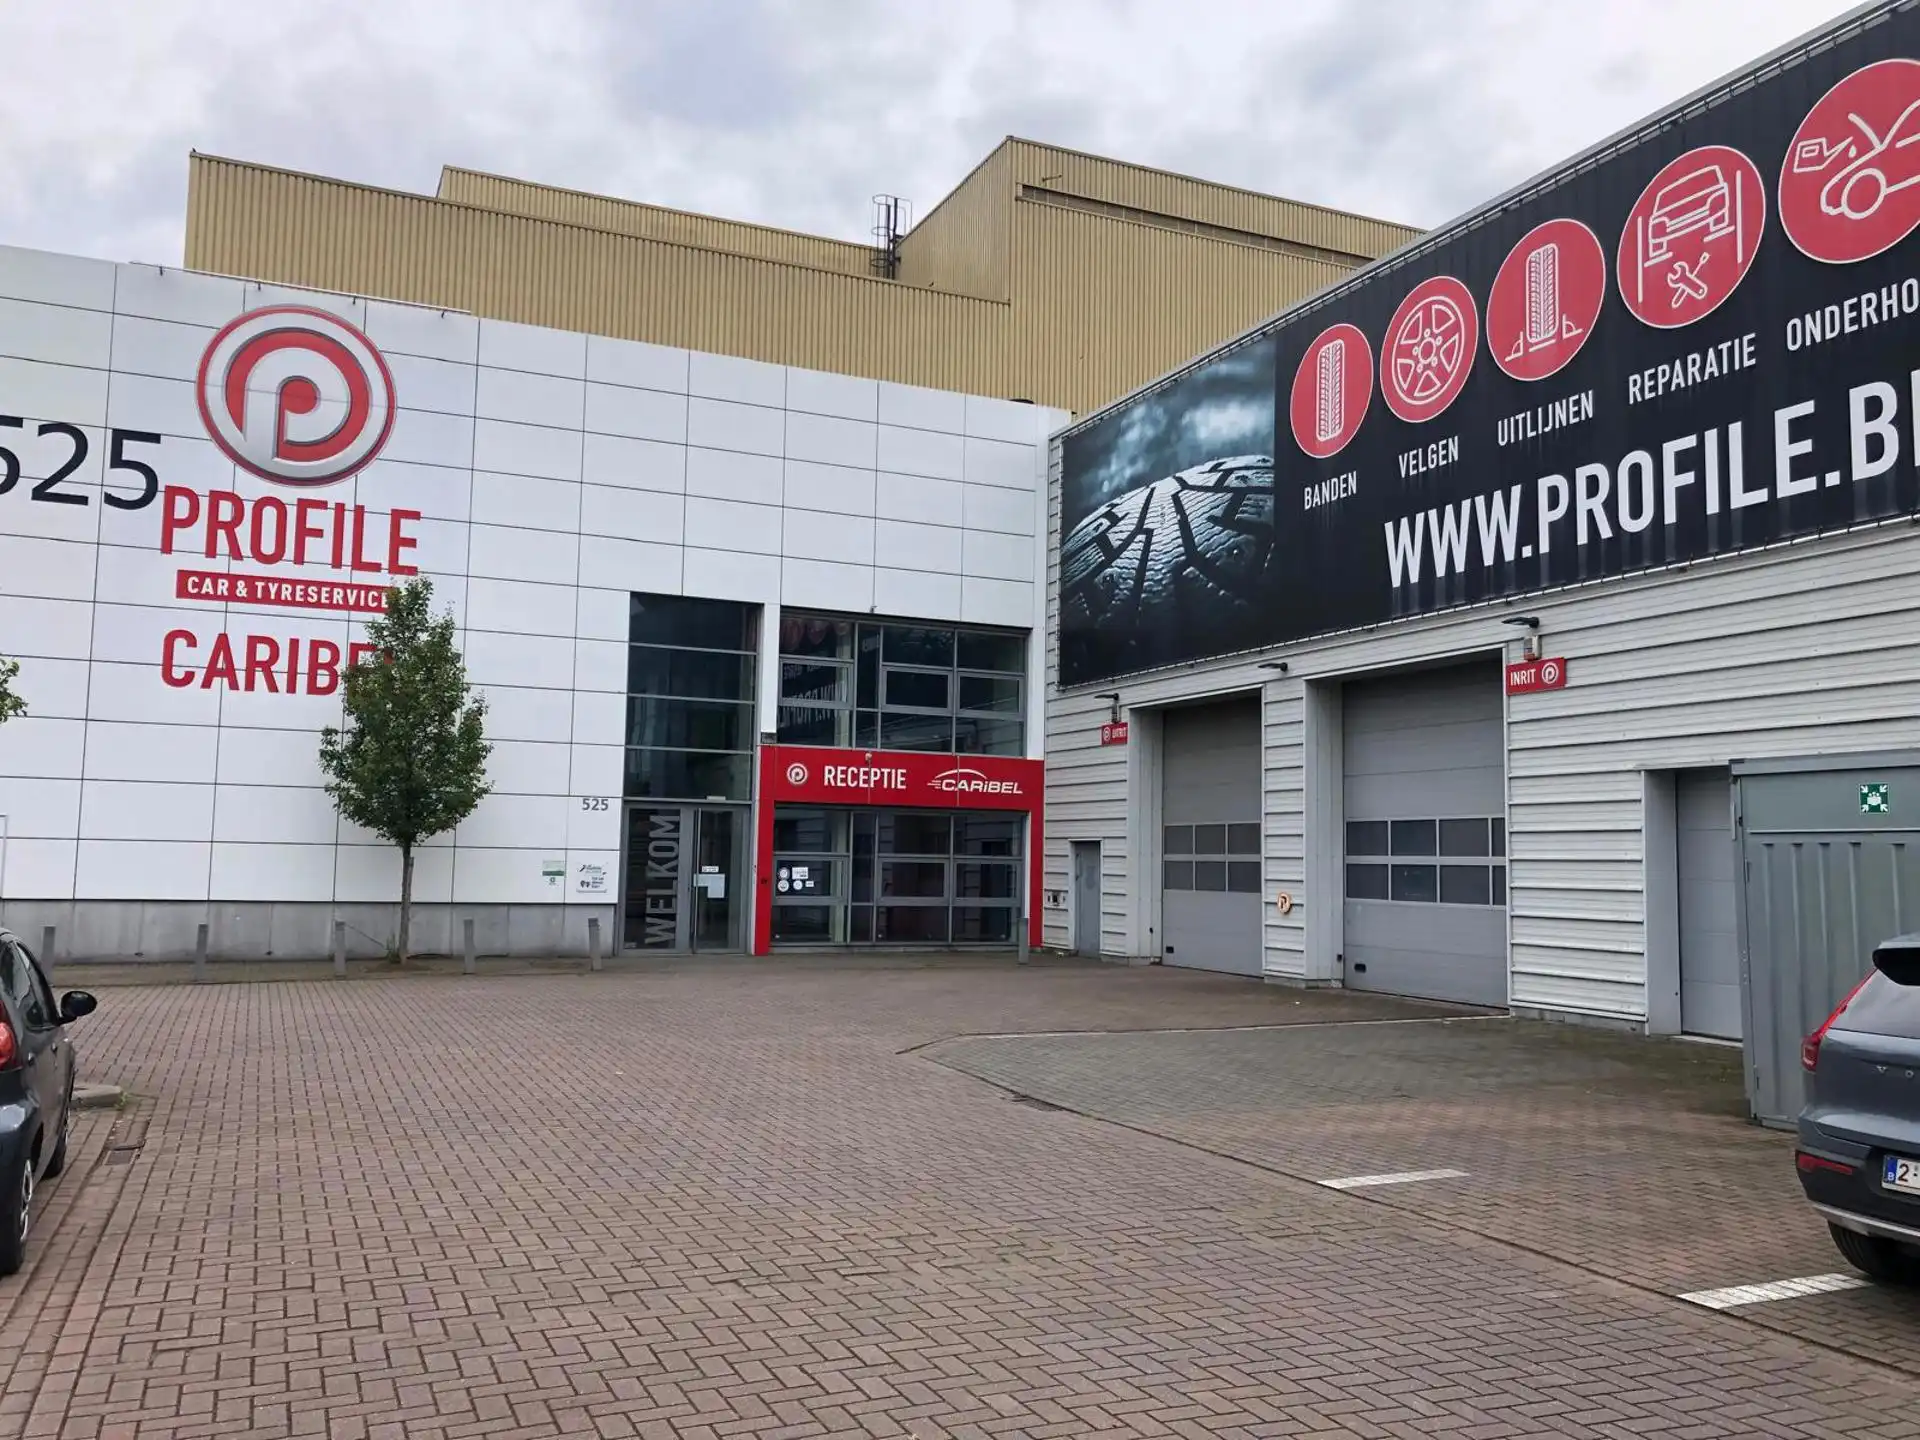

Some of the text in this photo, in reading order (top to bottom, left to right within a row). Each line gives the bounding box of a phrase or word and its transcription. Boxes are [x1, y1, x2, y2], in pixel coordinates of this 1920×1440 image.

[1786, 278, 1920, 351] ONDERHO
[1628, 333, 1757, 405] REPARATIE
[1498, 389, 1594, 447] UITLIJNEN
[1384, 368, 1920, 588] WWW.PROFILE.B
[1398, 435, 1460, 479] VELGEN
[1303, 471, 1358, 511] BANDEN
[160, 484, 422, 577] PROFILE
[187, 576, 229, 597] CAR
[236, 580, 248, 598] &
[1510, 668, 1537, 687] INRIT
[823, 765, 907, 790] RECEPTIE
[582, 798, 609, 811] 525
[644, 815, 680, 944] WELKOM
